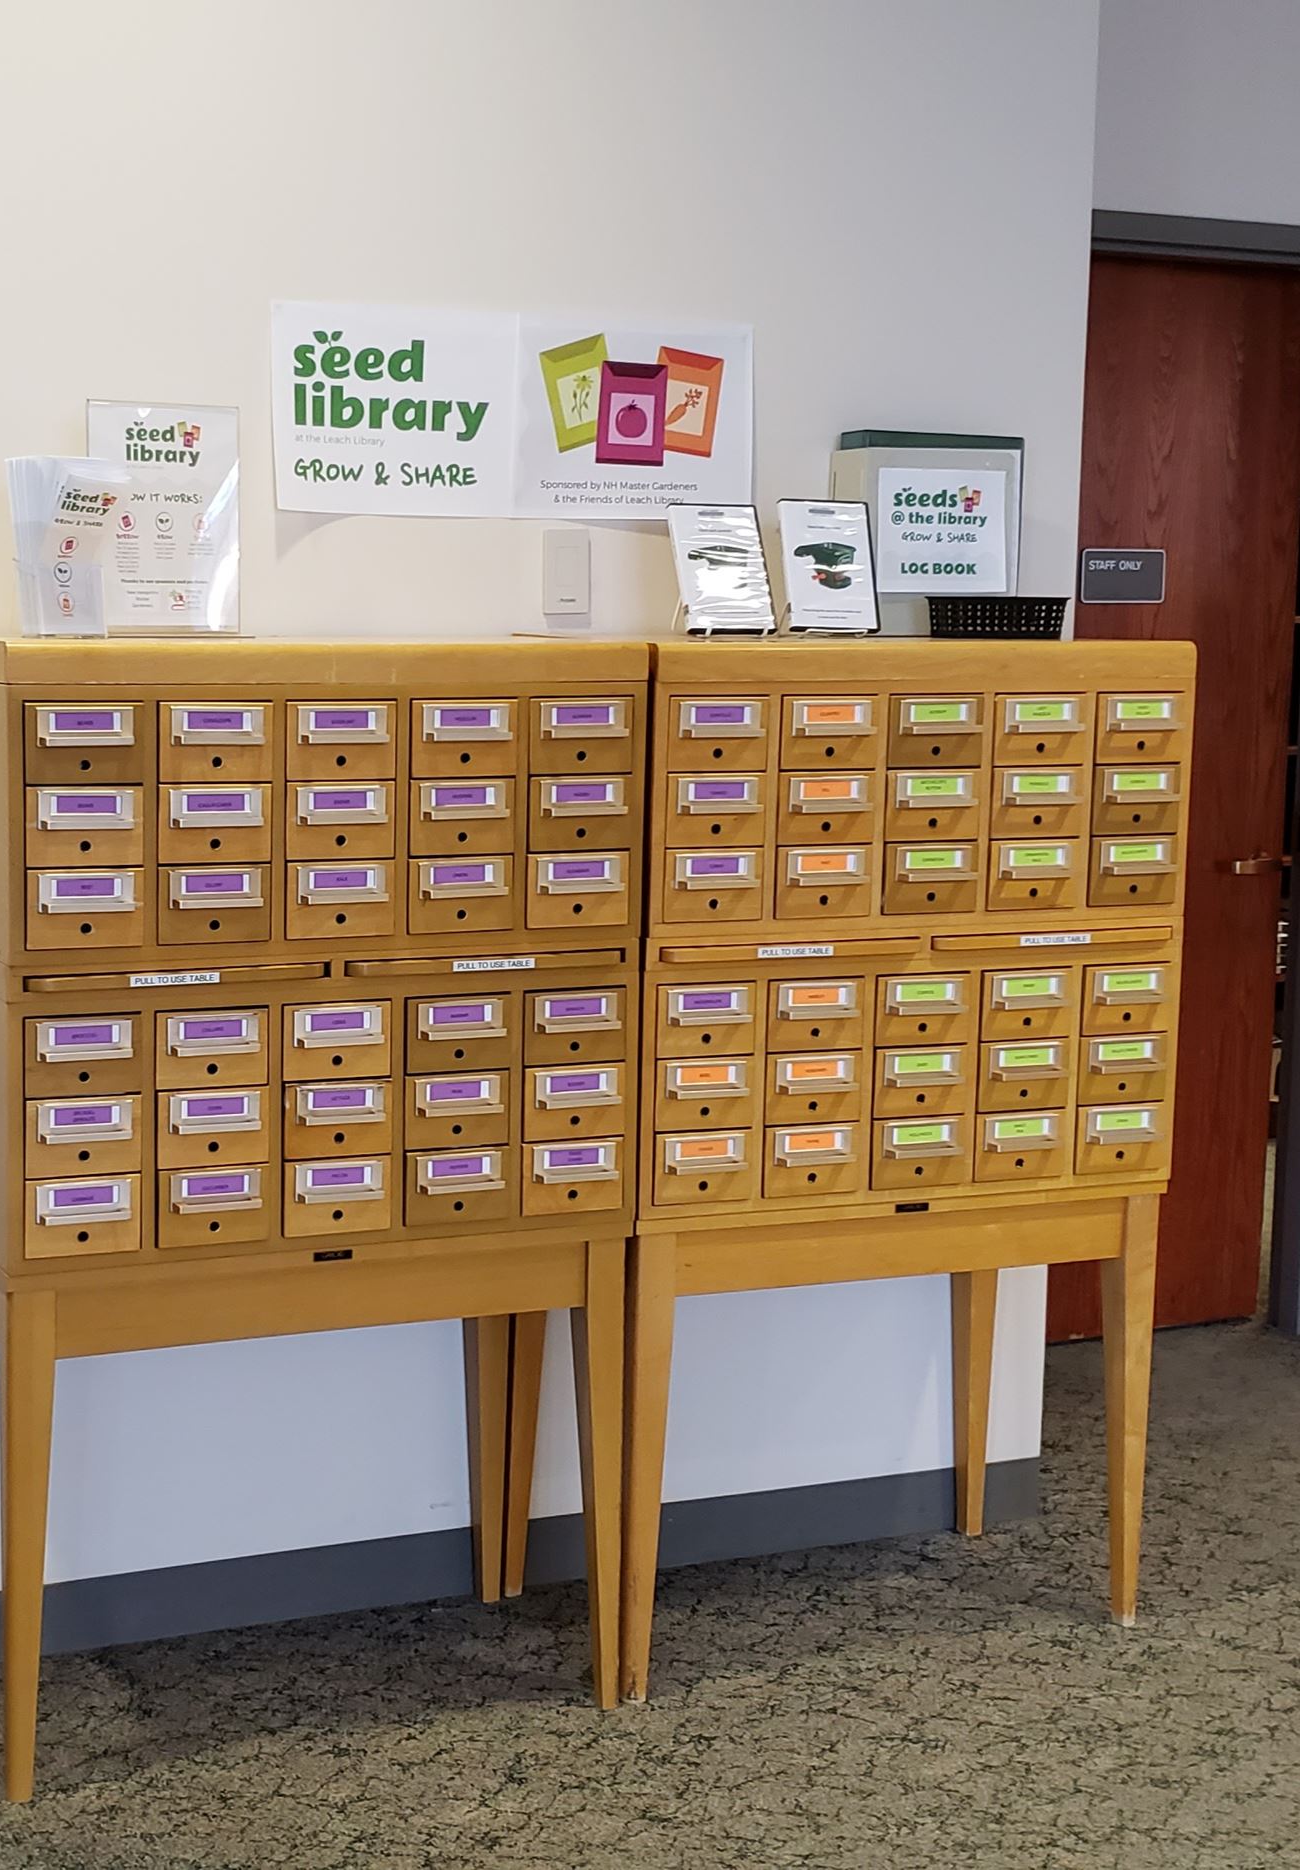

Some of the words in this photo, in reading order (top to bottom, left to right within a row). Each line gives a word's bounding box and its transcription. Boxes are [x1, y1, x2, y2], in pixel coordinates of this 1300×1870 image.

[293, 340, 425, 382] seed
[294, 381, 490, 442] library
[125, 425, 175, 443] seed
[295, 435, 304, 443] at
[306, 434, 321, 443] the
[323, 435, 351, 445] Leach
[354, 436, 385, 448] Library
[125, 443, 201, 467] library
[294, 458, 364, 483] GROW
[374, 461, 390, 486] &
[400, 462, 478, 488] SHARE
[540, 479, 587, 491] Sponsored
[590, 481, 601, 491] by
[603, 481, 617, 490] NH
[619, 481, 650, 491] Master
[651, 482, 698, 491] Gardeners
[64, 490, 99, 503] seed
[150, 493, 160, 501] IT
[163, 493, 203, 504] WORKS:
[553, 494, 560, 504] &
[562, 495, 577, 504] the
[579, 495, 613, 504] Friends
[614, 495, 624, 504] of
[625, 495, 652, 505] Leach
[893, 489, 958, 508] seeds
[60, 500, 110, 516] library
[891, 510, 905, 525] @
[908, 511, 934, 525] the
[937, 511, 988, 528] library
[901, 531, 933, 542] GROW
[936, 532, 943, 543] &
[947, 532, 978, 543] SHARE
[901, 562, 929, 574] LOG
[932, 563, 977, 575] BOOK
[1088, 560, 1116, 571] STAFF
[1118, 560, 1142, 571] ONLY
[457, 962, 476, 970] PULL
[134, 977, 155, 985] PULL
[157, 976, 169, 984] TO
[170, 975, 187, 983] USE
[189, 974, 215, 982] TABLE
